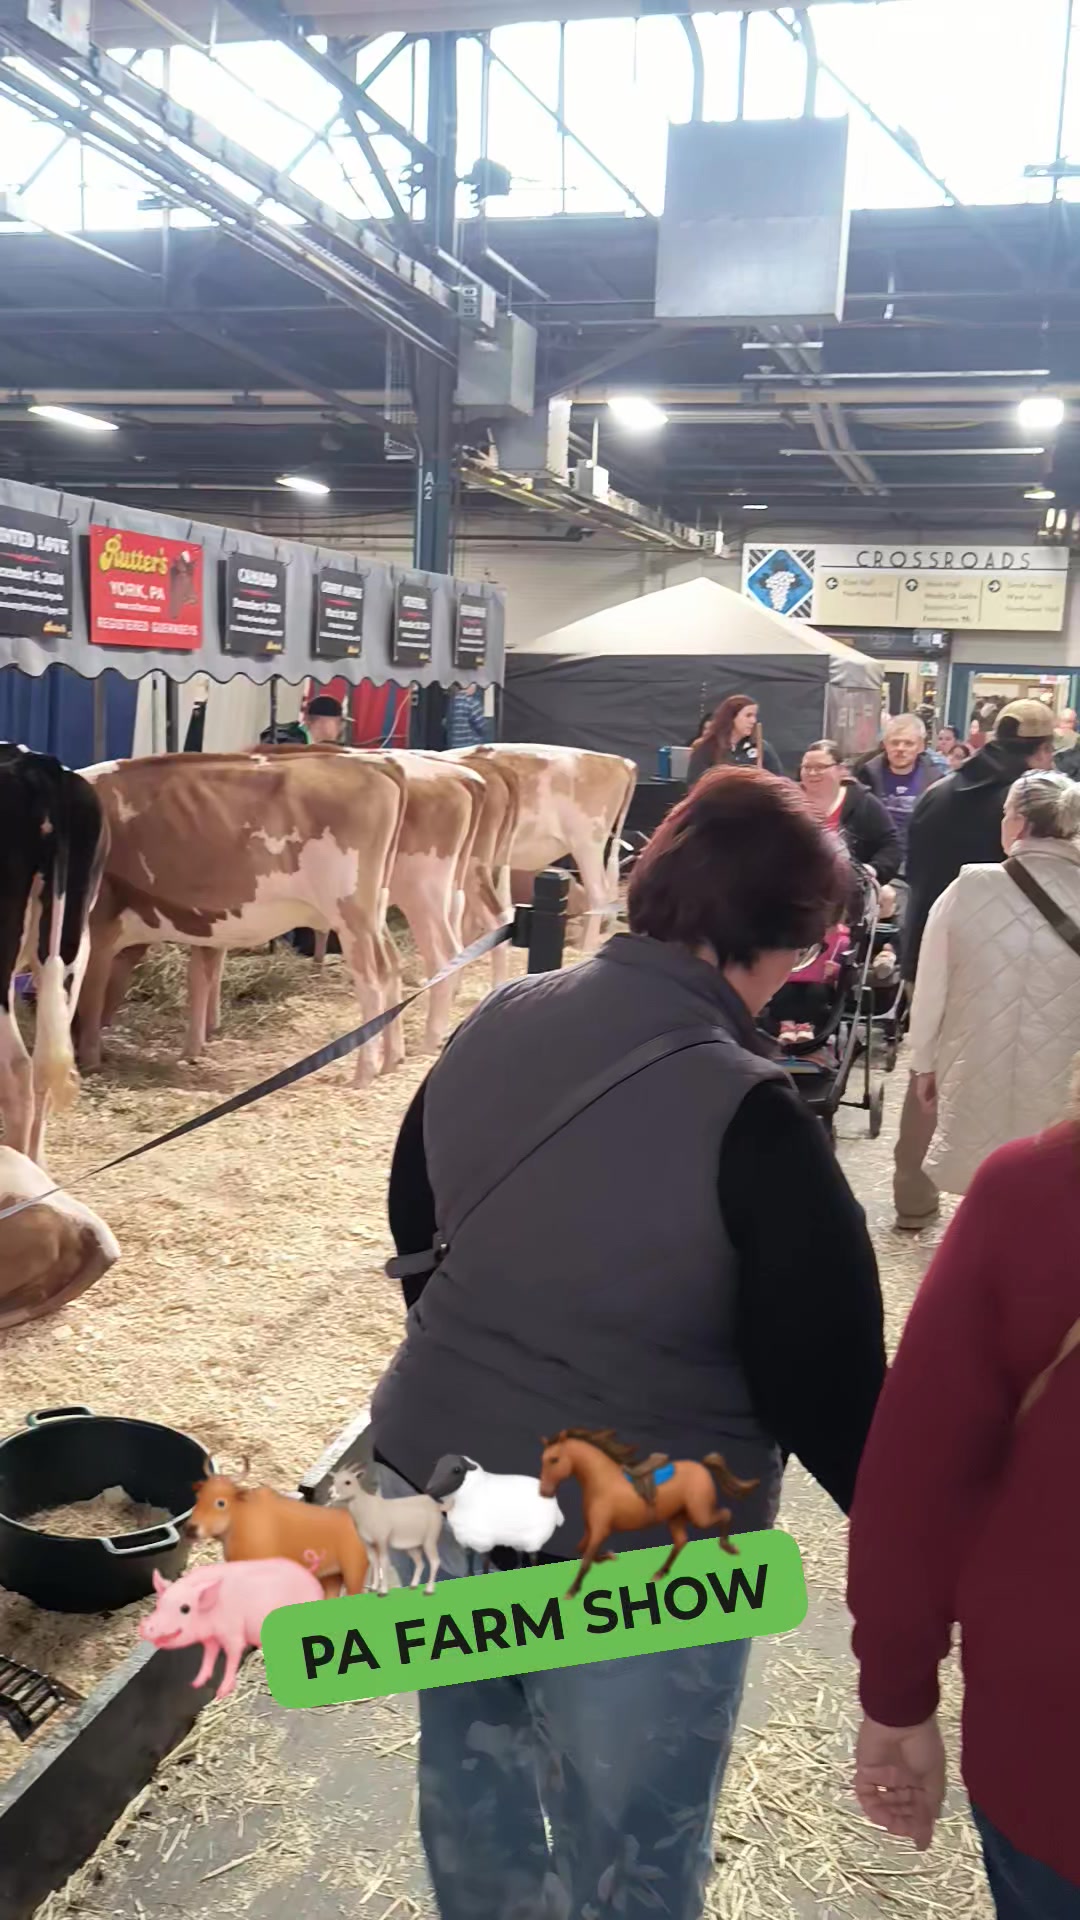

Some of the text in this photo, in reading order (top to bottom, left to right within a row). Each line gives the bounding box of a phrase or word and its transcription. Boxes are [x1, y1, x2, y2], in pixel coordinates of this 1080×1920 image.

[98, 533, 168, 575] Rutter's
[857, 550, 1030, 570] CROSSROADS
[109, 581, 165, 600] YORK, PA
